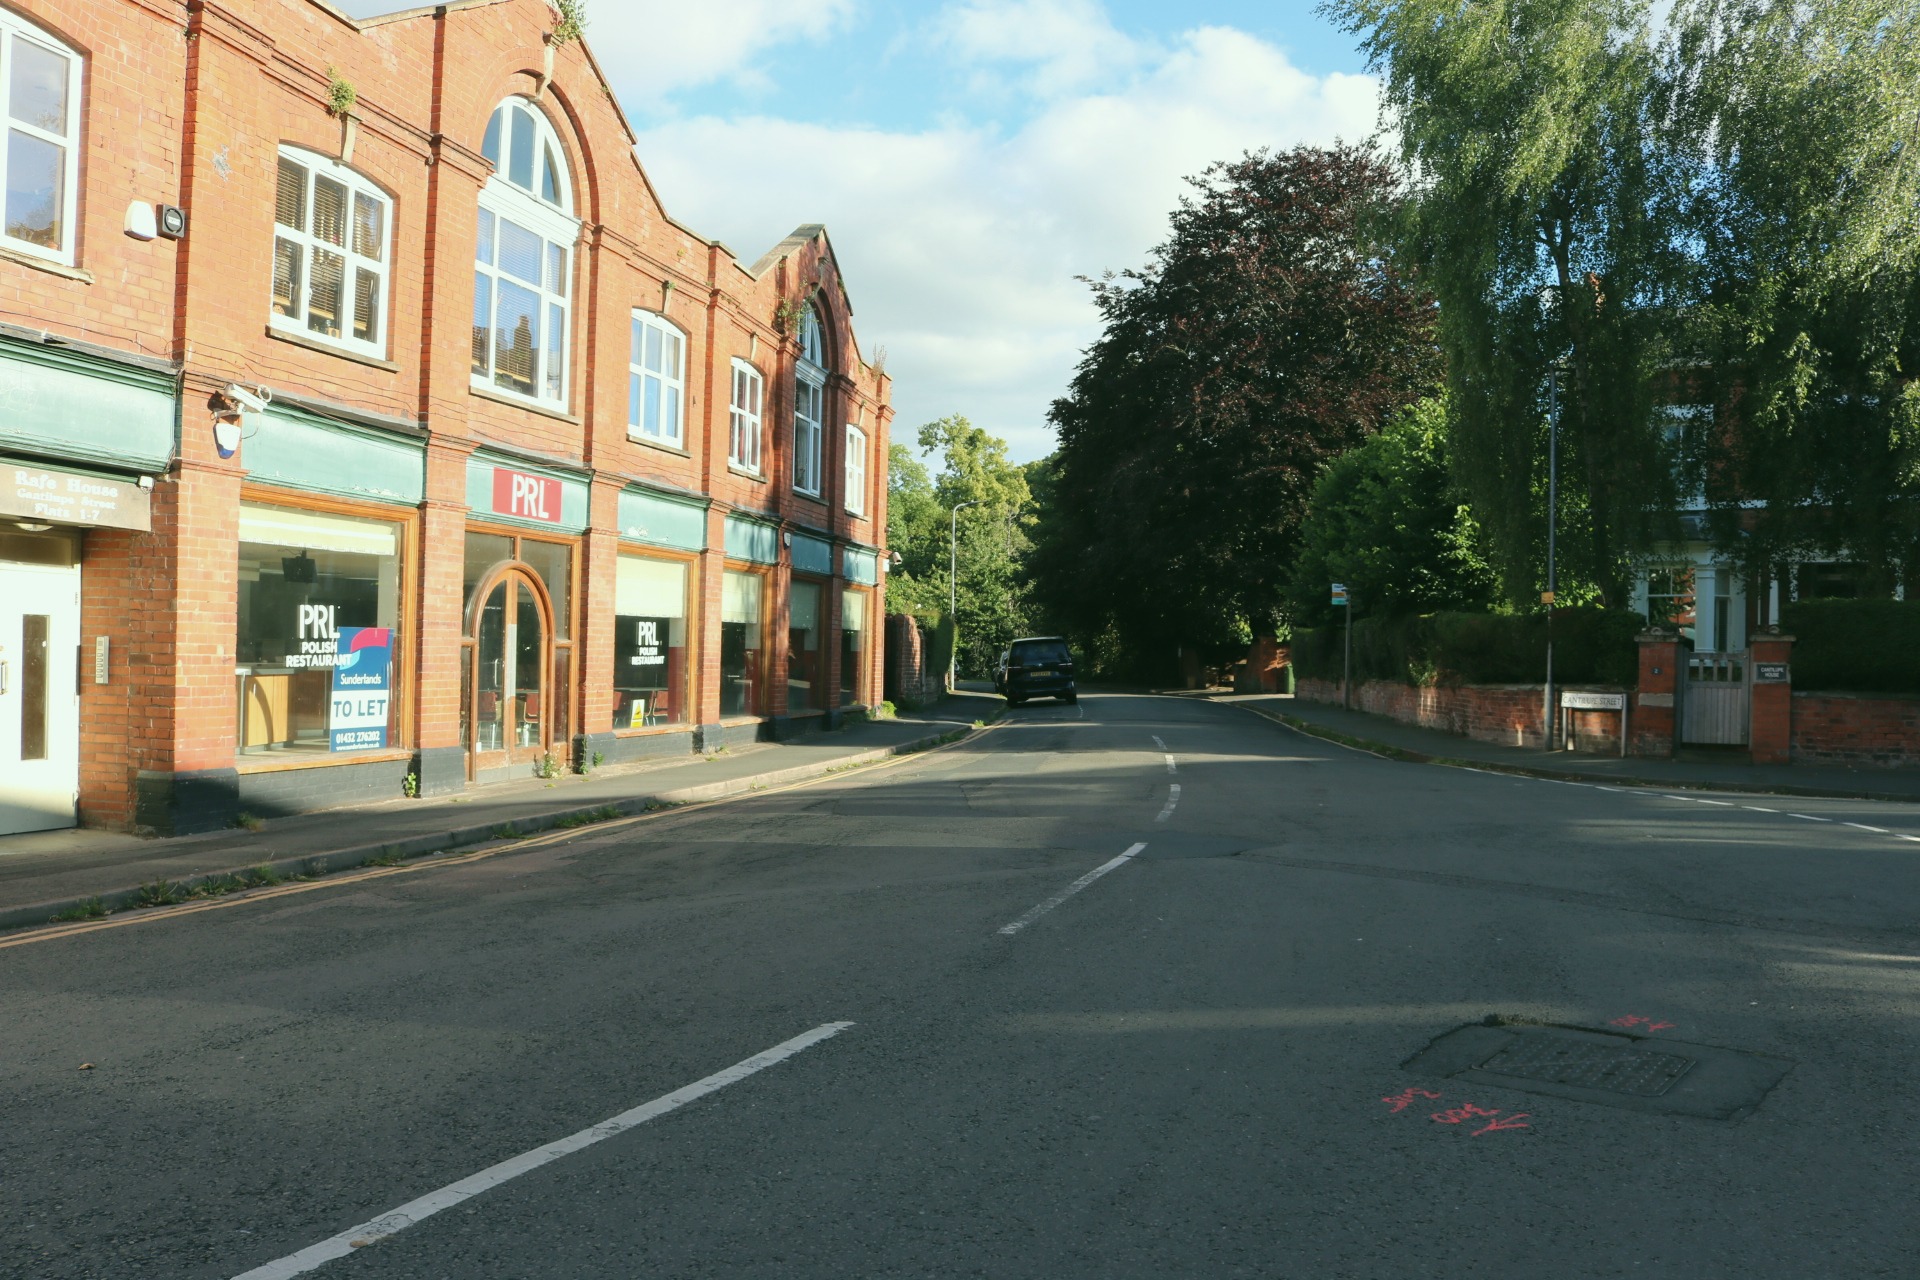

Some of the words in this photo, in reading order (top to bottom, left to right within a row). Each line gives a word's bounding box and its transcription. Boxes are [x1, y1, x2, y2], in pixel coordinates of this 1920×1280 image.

[15, 470, 57, 490] Rafe
[66, 478, 118, 498] House
[80, 496, 116, 509] Street
[511, 473, 549, 519] PRL
[34, 502, 71, 518] Flats
[79, 508, 100, 521] 1-7
[299, 604, 340, 639] PRL
[638, 621, 660, 646] PRL
[301, 641, 338, 654] POLISH
[639, 646, 658, 656] POLISH
[285, 653, 353, 668] RESTAURANT
[631, 655, 665, 666] RESTAURANT
[340, 673, 382, 685] Sunderlands
[333, 700, 353, 718] TO
[357, 699, 387, 717] LET
[1599, 697, 1621, 706] STREET
[336, 732, 356, 745] 01432
[356, 730, 380, 743] 276202
